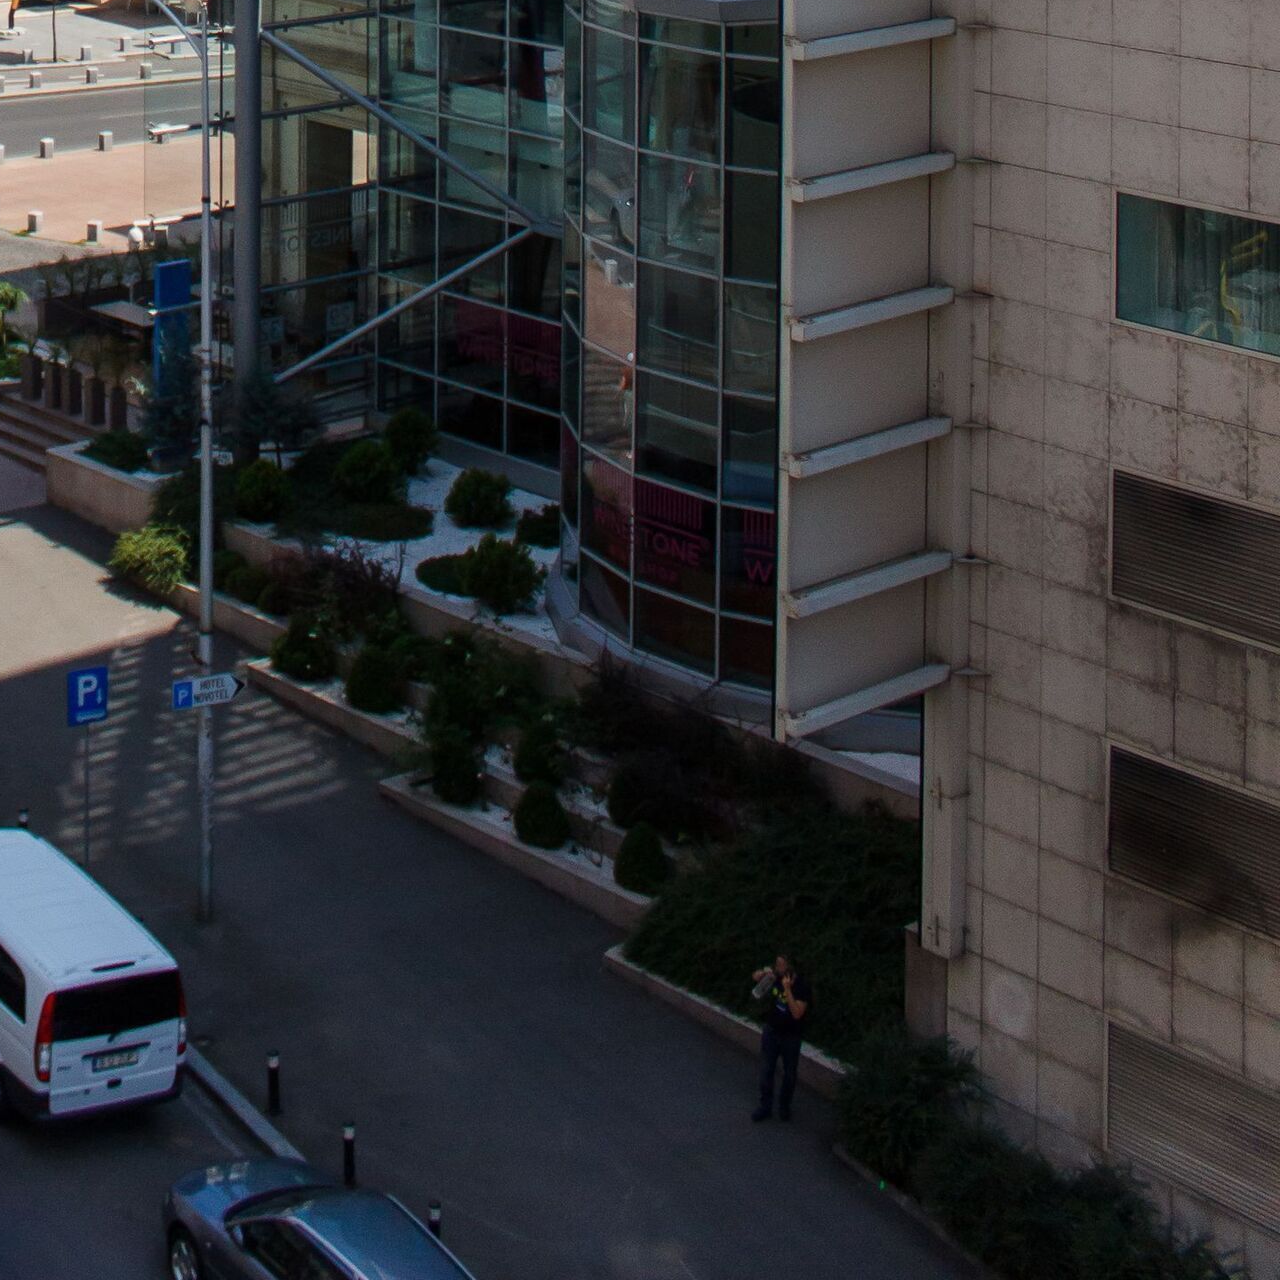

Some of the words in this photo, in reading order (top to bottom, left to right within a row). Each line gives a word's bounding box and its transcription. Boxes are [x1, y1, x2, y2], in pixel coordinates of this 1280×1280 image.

[592, 507, 701, 567] WINETONE
[77, 674, 98, 706] P
[200, 677, 225, 689] HOTEL
[178, 689, 189, 705] P
[193, 690, 230, 704] NOVOTEL
